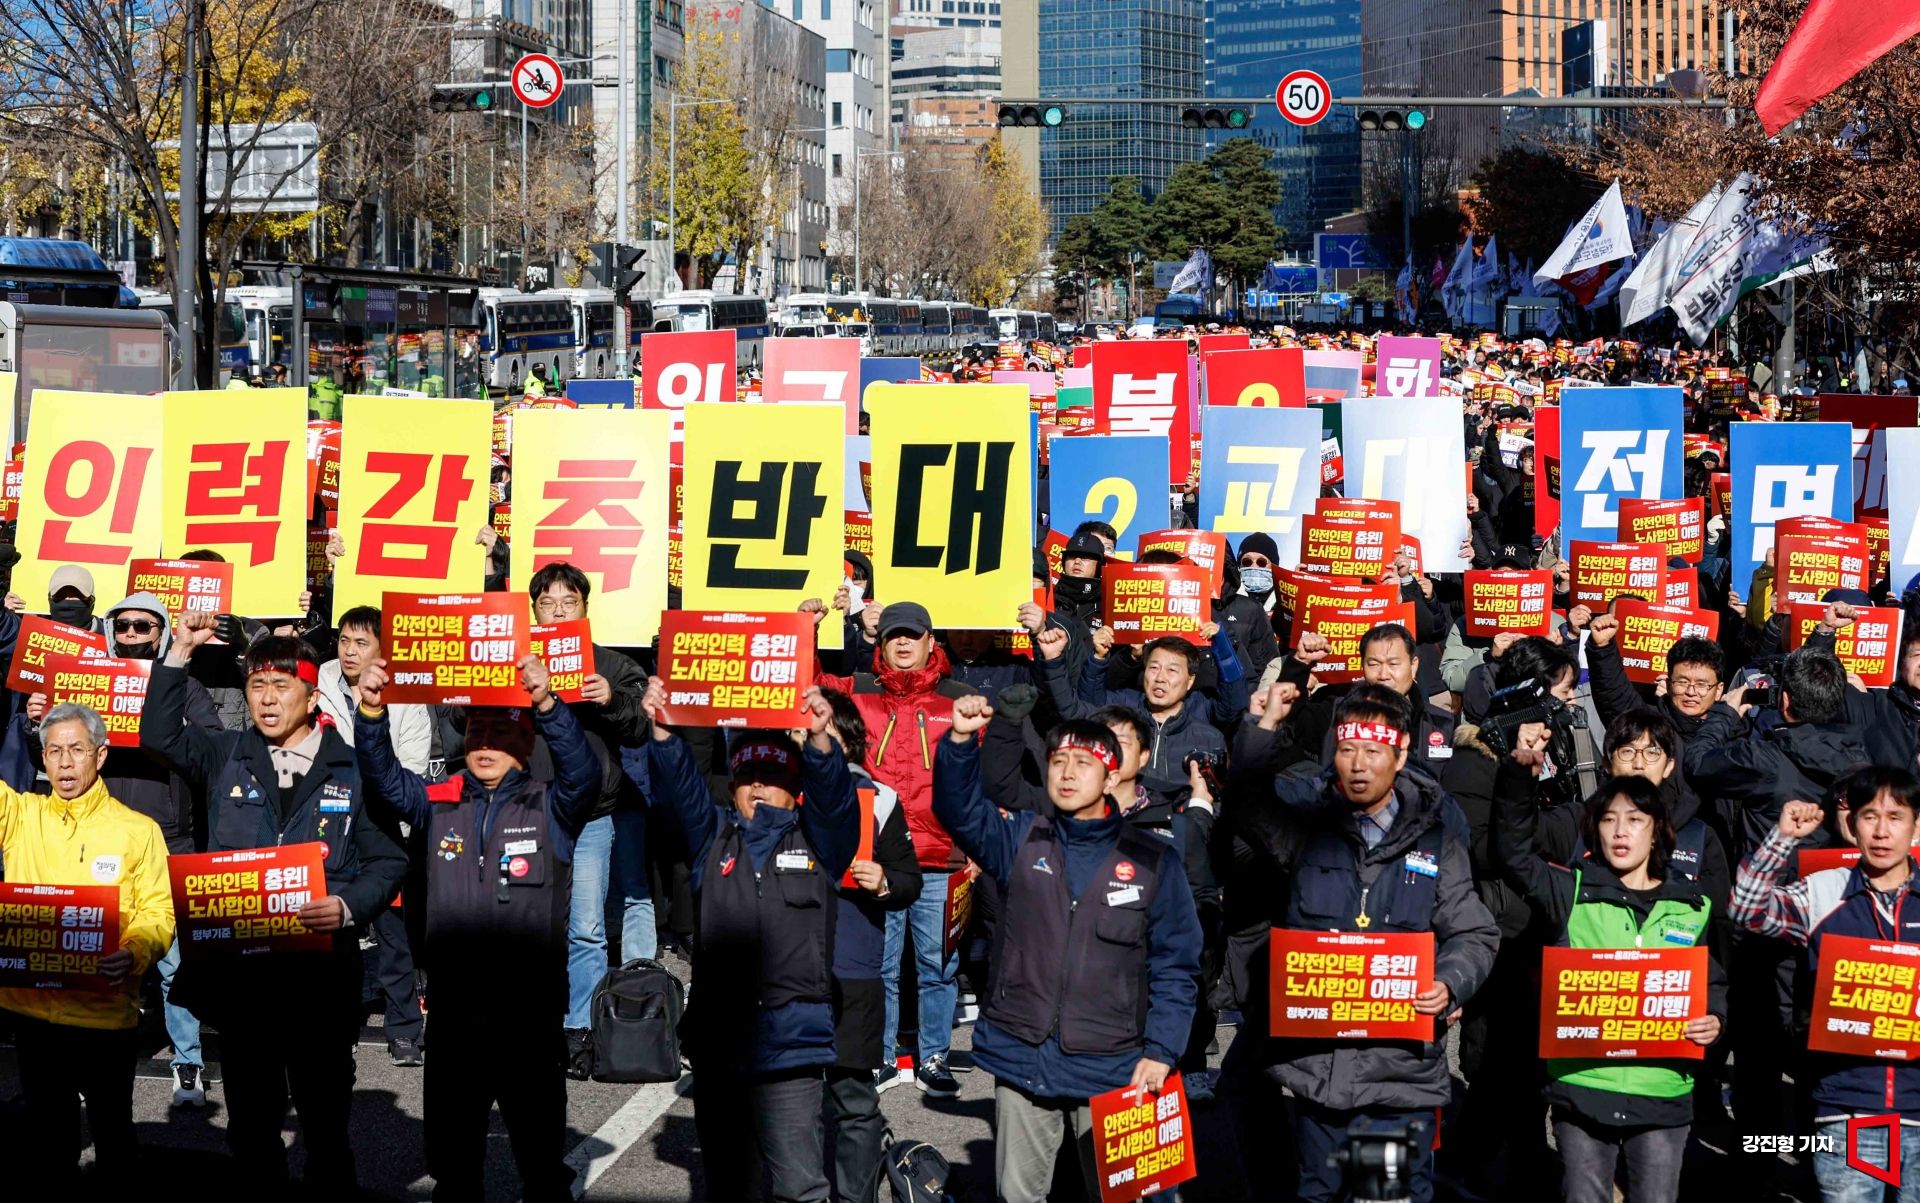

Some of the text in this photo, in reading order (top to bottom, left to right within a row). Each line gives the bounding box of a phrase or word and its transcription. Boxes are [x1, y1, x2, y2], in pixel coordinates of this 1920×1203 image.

[1288, 85, 1319, 112] 50
[1574, 429, 1670, 528] 전
[1213, 446, 1306, 534] 교
[37, 440, 154, 565] 인
[185, 440, 291, 567] 력
[891, 441, 1015, 575] 대
[355, 451, 475, 580] 감
[706, 461, 827, 590] 반
[1084, 477, 1137, 562] 2
[1632, 510, 1700, 529] 안전인력 충원!
[533, 460, 646, 594] 축
[1309, 528, 1383, 545] 안전인력 충원!
[1635, 526, 1700, 543] 노사합의 이행!
[1188, 542, 1216, 556] 충원!
[1307, 545, 1383, 561] 노사합의 이행!
[1307, 561, 1381, 576] 정부기준 임금인상!
[1579, 555, 1658, 571] 안전인력 충원!
[1789, 552, 1863, 573] 안전인력 충원!
[134, 573, 221, 593] 안전인력 충원!
[1114, 580, 1200, 596] 안전인력 충원!
[1578, 571, 1657, 587] 노사합의 이행!
[1788, 570, 1860, 590] 노사합의 이행!
[1473, 583, 1545, 597] 안전인력 충원!
[1577, 592, 1602, 601] 정부기준
[1787, 592, 1816, 601] 정부기준
[187, 595, 220, 611] 이행!
[1113, 598, 1200, 613] 노사합의 이행!
[1473, 598, 1544, 613] 노사합의 이행!
[392, 614, 514, 638] 안전인력 충원!
[1113, 617, 1200, 631] 정부기준 임금인상!
[1318, 621, 1370, 638] 안전인력
[1474, 614, 1543, 628] 정부기준 임금인상!
[1625, 615, 1709, 638] 안전인력 충원!
[1857, 623, 1888, 639] 충원!
[28, 631, 82, 659] 안전인력
[392, 640, 514, 662] 노사합의 이행!
[547, 637, 580, 655] 충원!
[672, 632, 796, 656] 안전인력 충원!
[1623, 634, 1678, 653] 노사합의
[1857, 641, 1887, 657] 이행!
[549, 655, 583, 673] 이행!
[671, 659, 796, 684] 노사합의 이행!
[1317, 662, 1346, 672] 정부기준
[1623, 657, 1650, 669] 정부기준
[54, 671, 147, 693] 안전인력 충원!
[394, 665, 515, 687] 정부기준 임금인상!
[113, 694, 146, 713] 이행!
[670, 685, 795, 710] 정부기준 임금인상!
[185, 865, 308, 896] 안전인력 충원!
[189, 892, 262, 918] 노사합의
[60, 906, 103, 927] 충원!
[61, 930, 103, 952] 이행!
[192, 927, 231, 941] 정부기준
[1286, 952, 1417, 977] 안전인력 충원!
[1834, 959, 1917, 990] 안전인력
[1286, 976, 1417, 999] 노사합의 이행!
[1558, 969, 1691, 993] 안전인력 충원!
[1286, 1001, 1416, 1023] 정부기준 임금인상!
[1557, 994, 1690, 1018] 노사합의 이행!
[1829, 986, 1914, 1017] 노사합의
[1556, 1026, 1599, 1040] 정부기준
[1827, 1016, 1871, 1036] 정부기준
[1103, 1091, 1180, 1140] 안전인력 충원!
[1105, 1116, 1183, 1165] 노사합의 이행!
[1108, 1141, 1186, 1189] 정부기준 임금인상!
